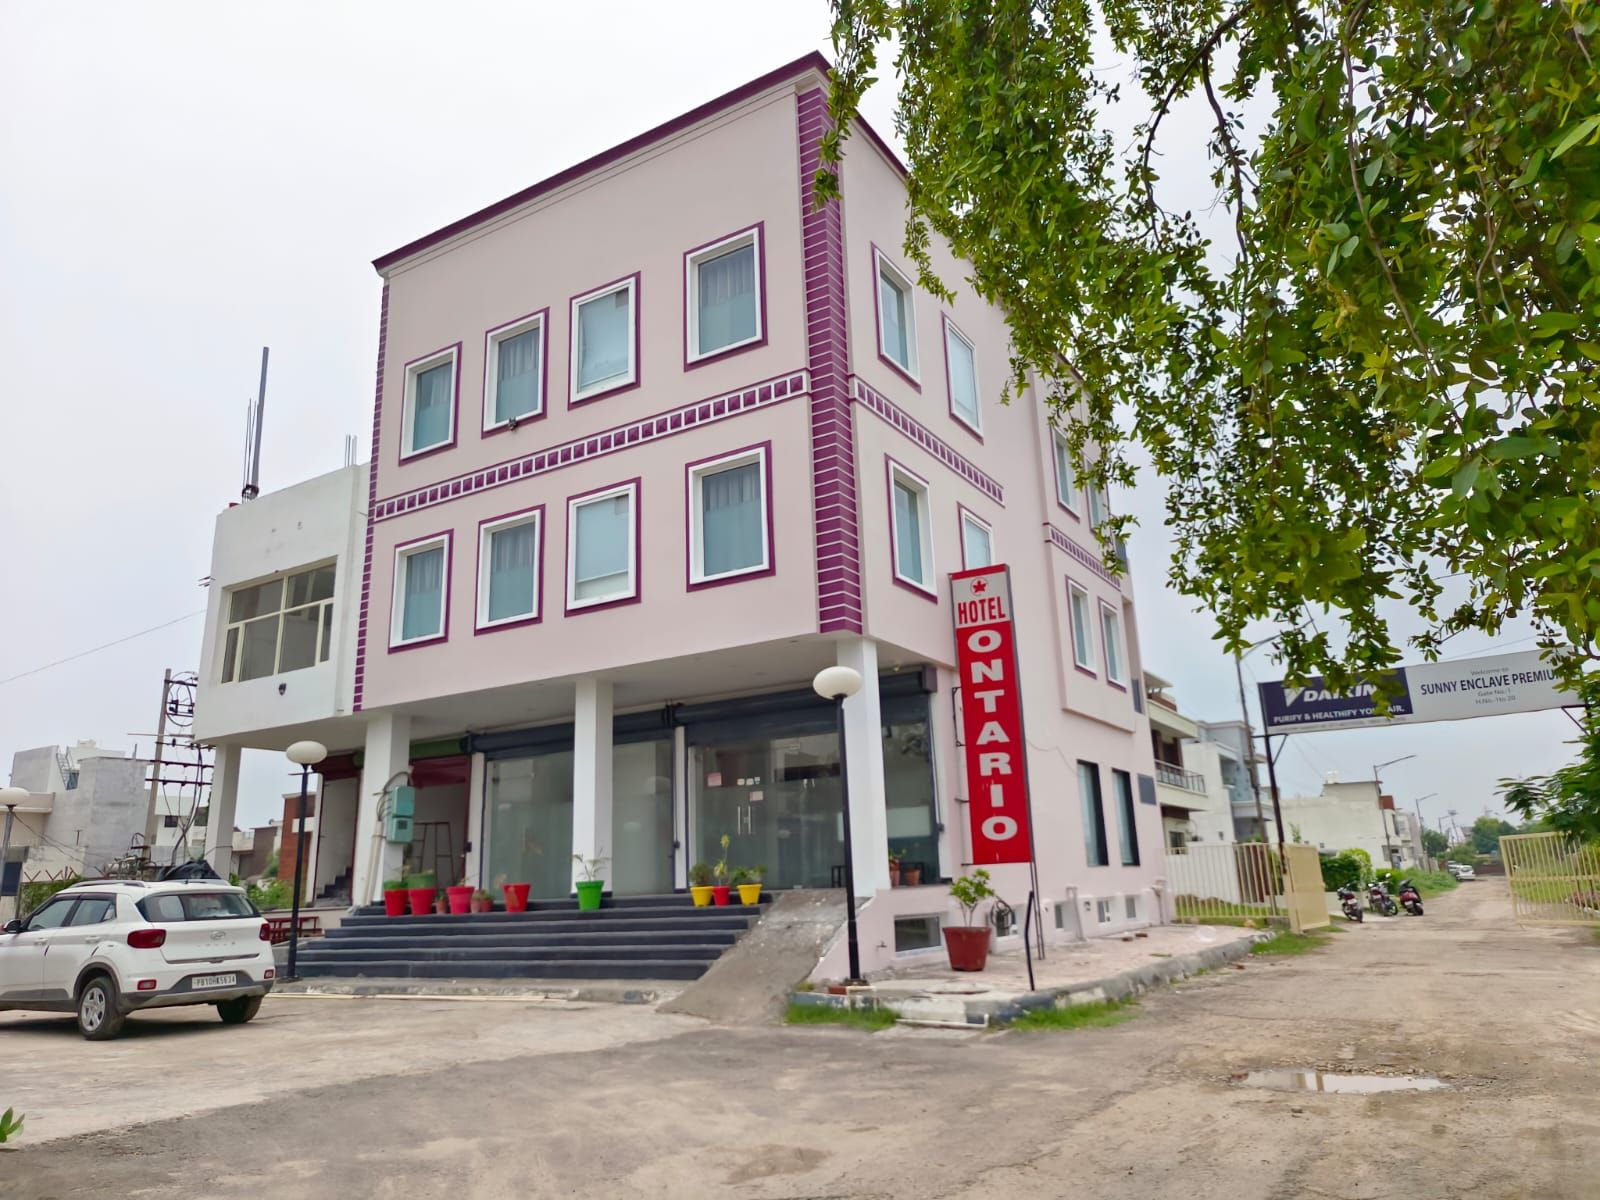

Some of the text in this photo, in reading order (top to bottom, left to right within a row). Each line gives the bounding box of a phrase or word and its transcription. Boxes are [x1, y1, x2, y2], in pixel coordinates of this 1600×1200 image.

[957, 596, 1006, 624] HOTEL
[1420, 680, 1457, 696] SUNNY
[1460, 674, 1511, 691] ENCLAVE
[1273, 713, 1303, 723] PURIFY
[1304, 713, 1311, 721] &
[1312, 709, 1358, 720] HEALTHIFY
[967, 629, 1018, 841] ONTARIO
